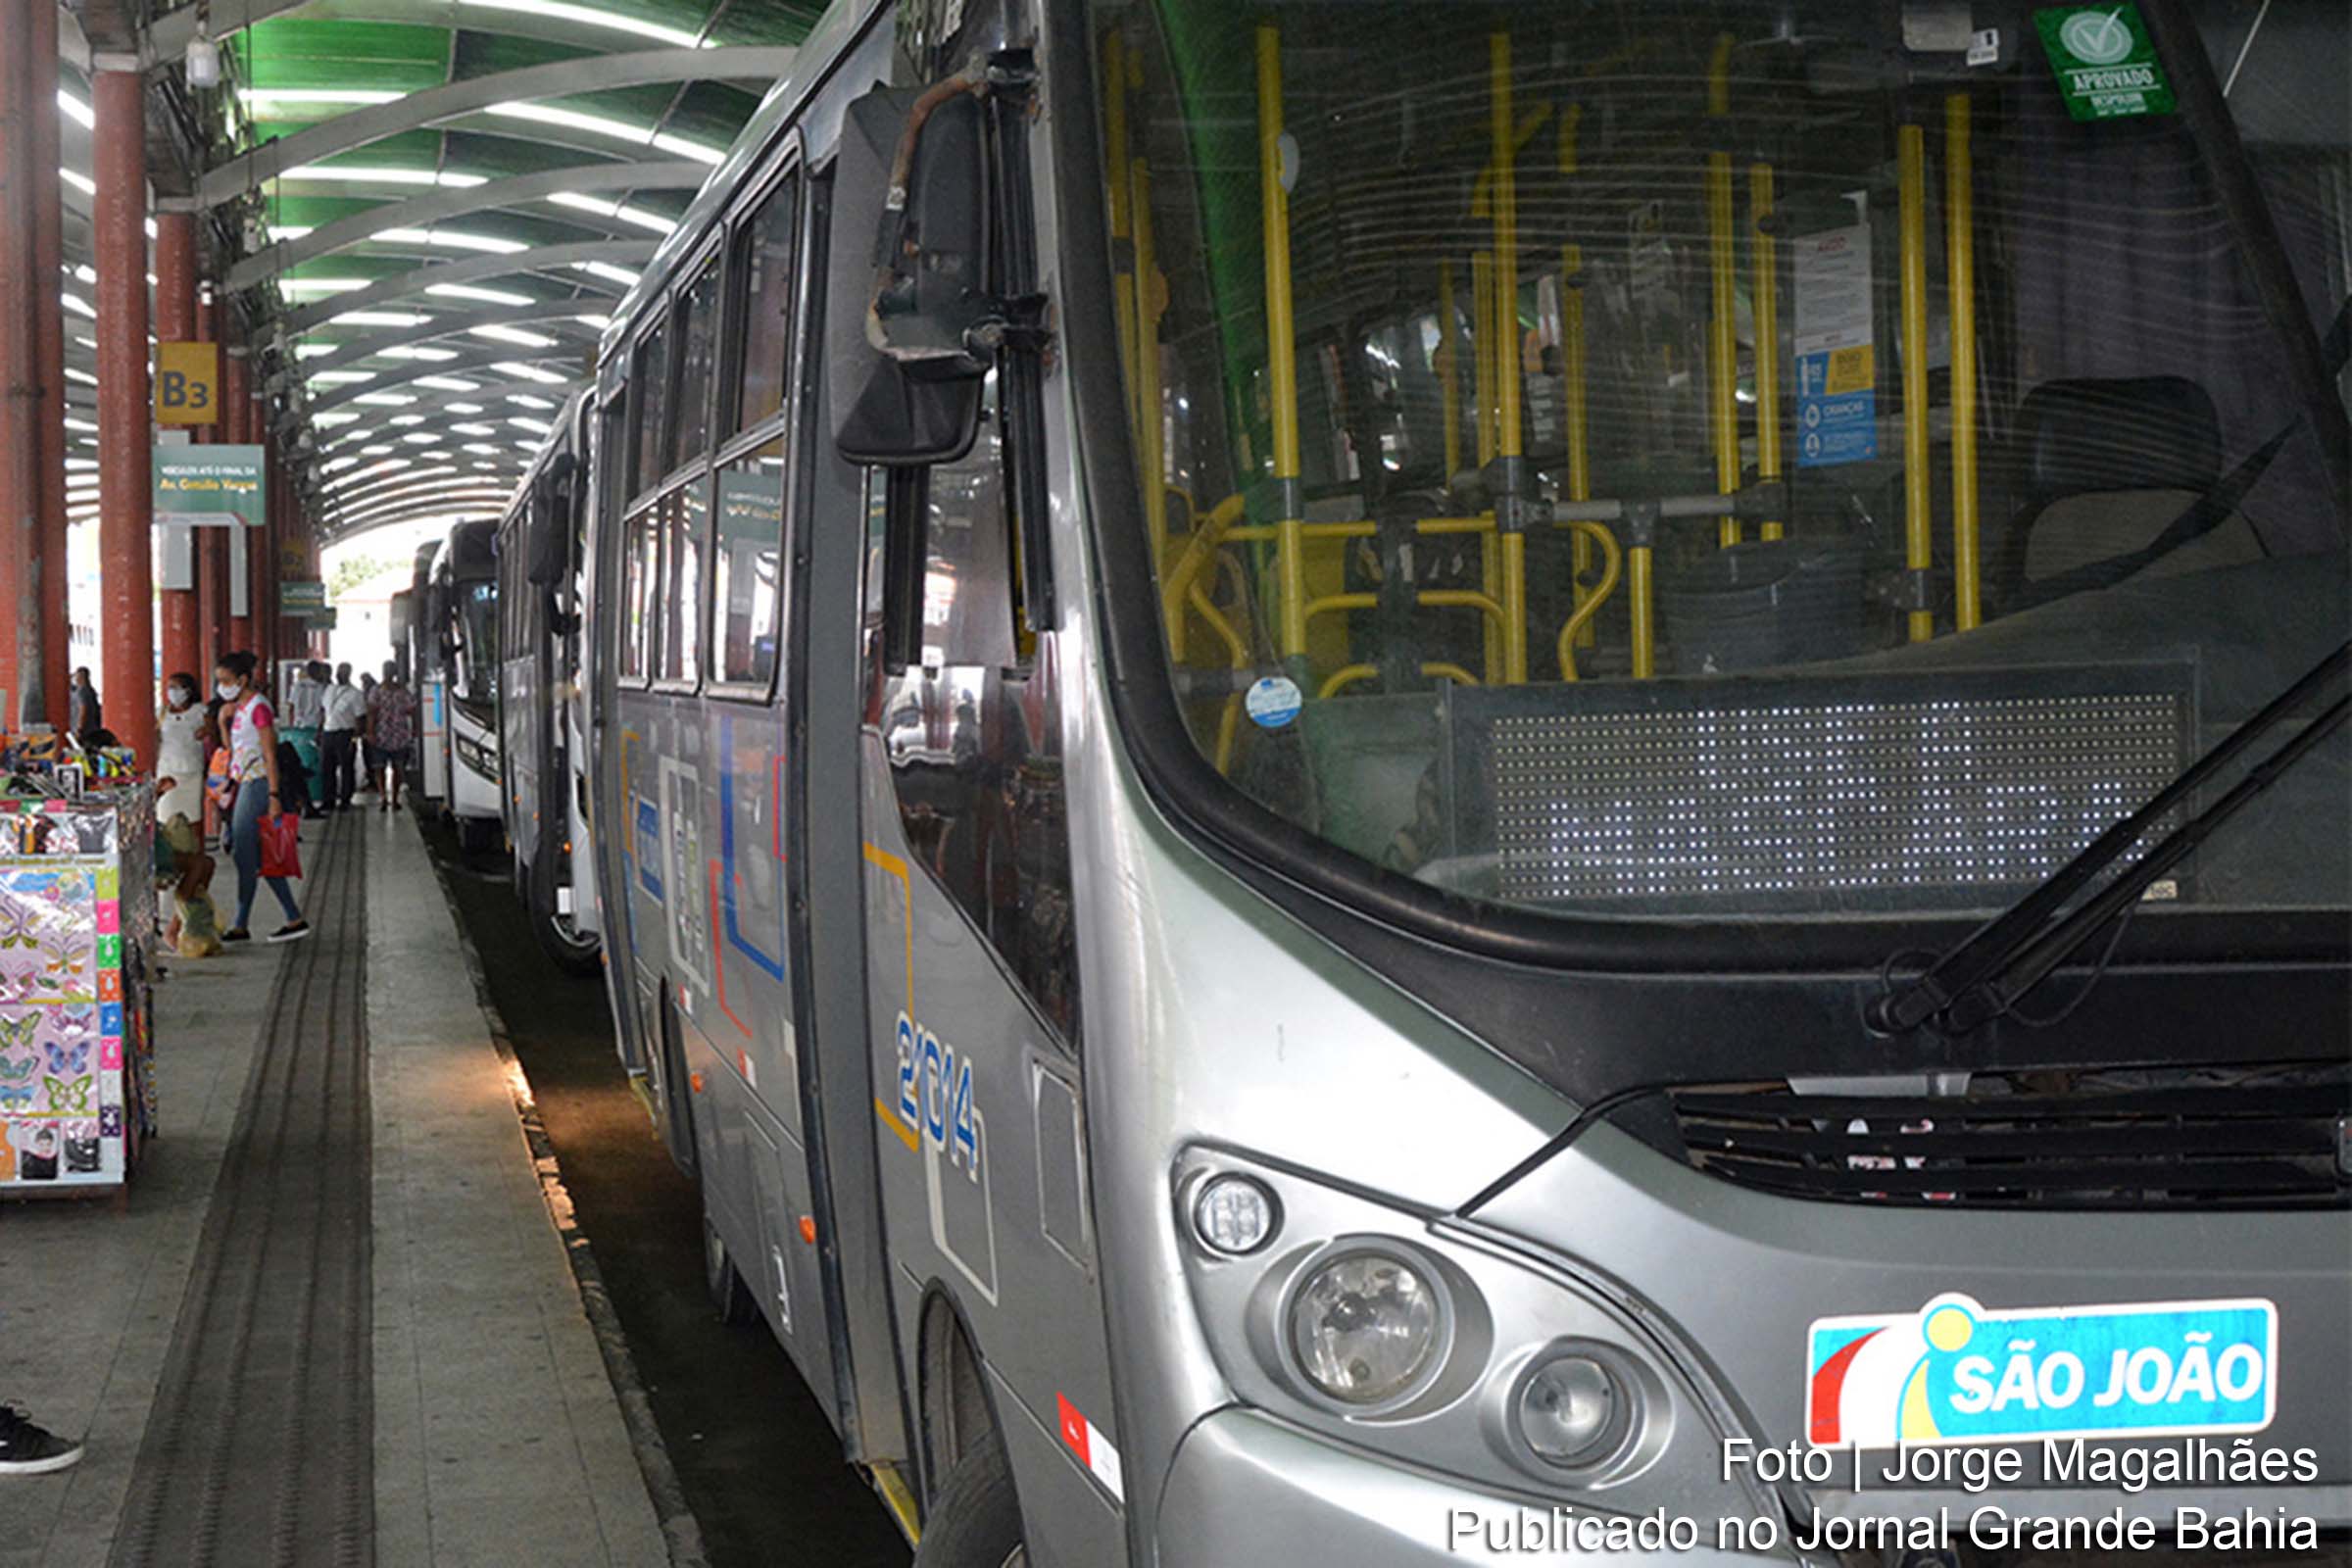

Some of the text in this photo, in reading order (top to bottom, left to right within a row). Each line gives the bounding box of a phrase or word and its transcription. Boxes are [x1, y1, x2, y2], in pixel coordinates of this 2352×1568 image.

[2073, 68, 2155, 91] APROVADO
[163, 370, 209, 409] B3
[1949, 1331, 2264, 1414] SÃO JOÃO
